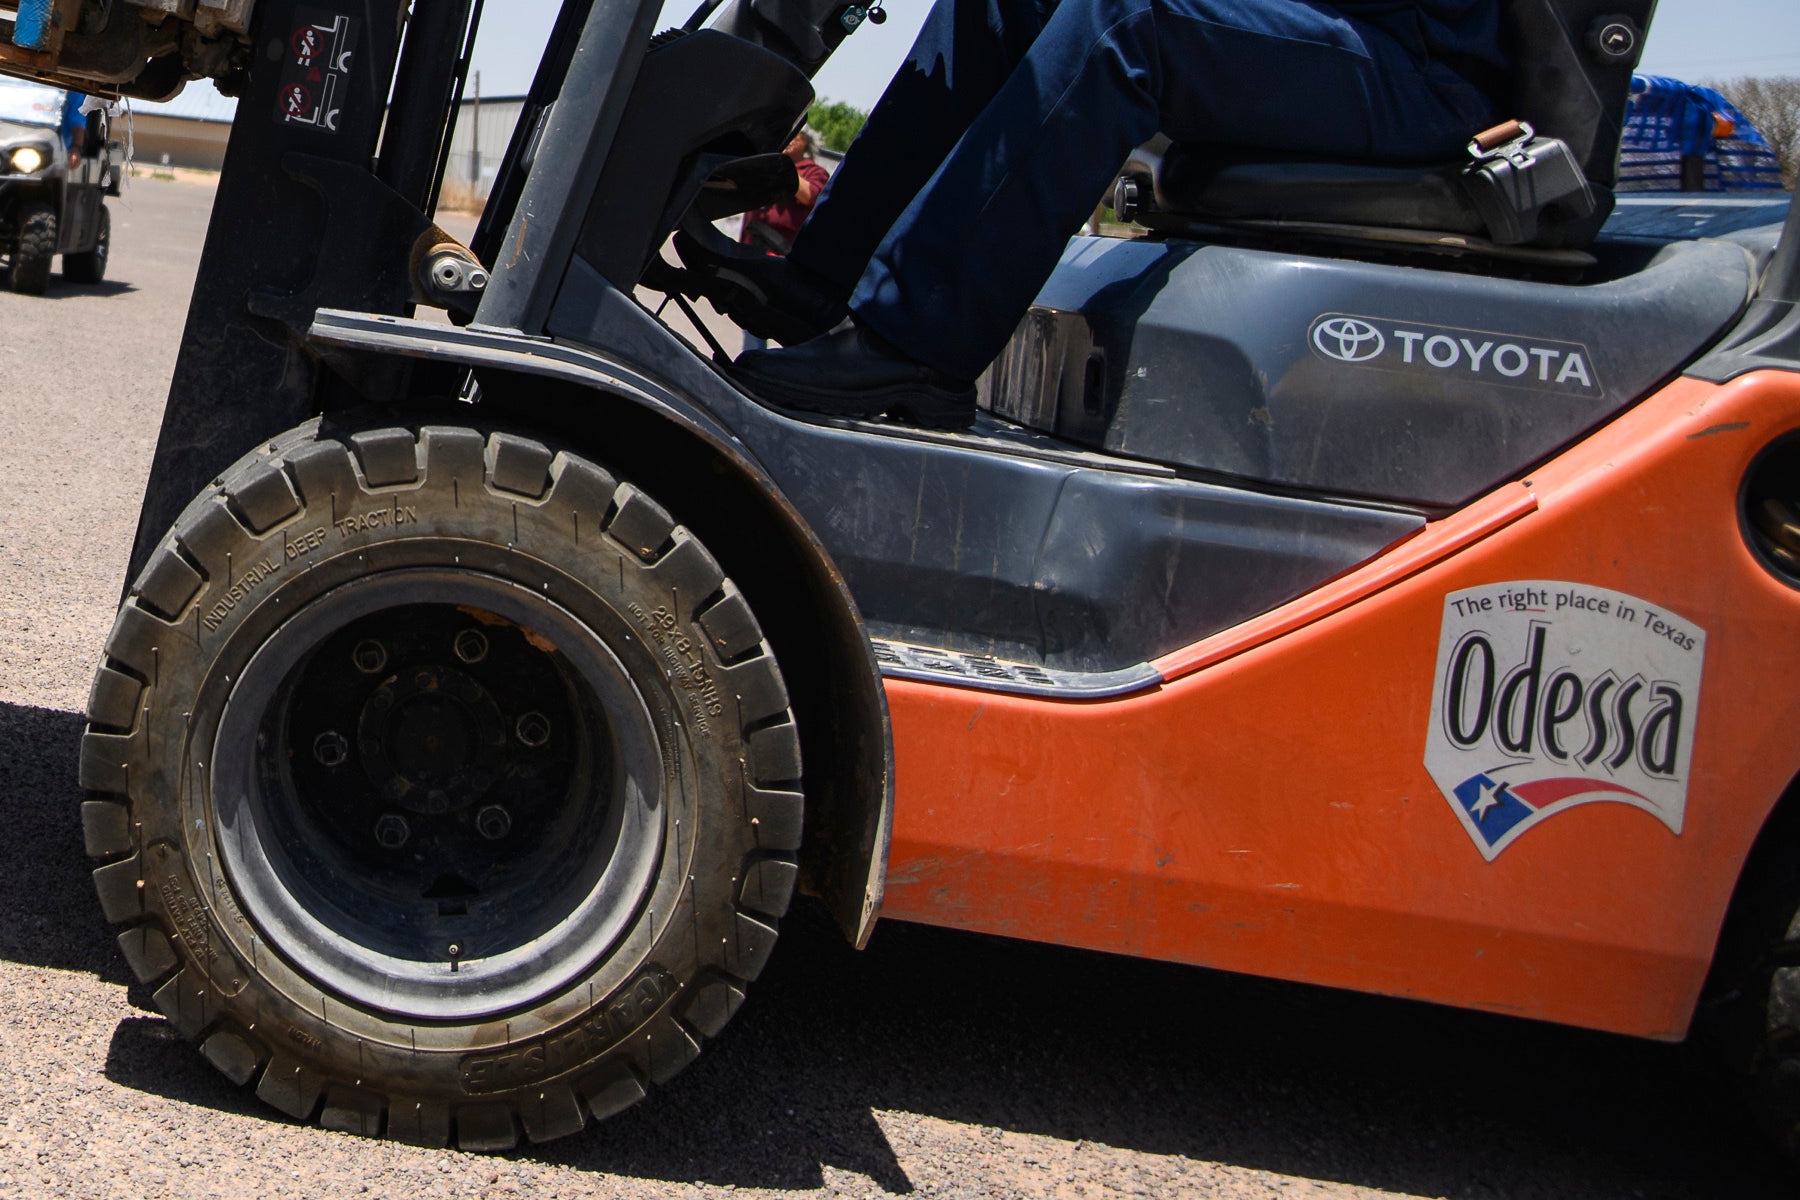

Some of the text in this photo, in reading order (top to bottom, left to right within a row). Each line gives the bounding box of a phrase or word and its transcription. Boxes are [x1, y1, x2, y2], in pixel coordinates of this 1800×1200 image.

[1393, 329, 1592, 387] TOYOTA
[203, 506, 417, 632] INDUSTRIAL DEEP TRACTION
[628, 602, 648, 623] NOT
[646, 622, 665, 646] FOR
[1450, 588, 1697, 654] The right place in Texas
[1445, 622, 1685, 778] Odessa
